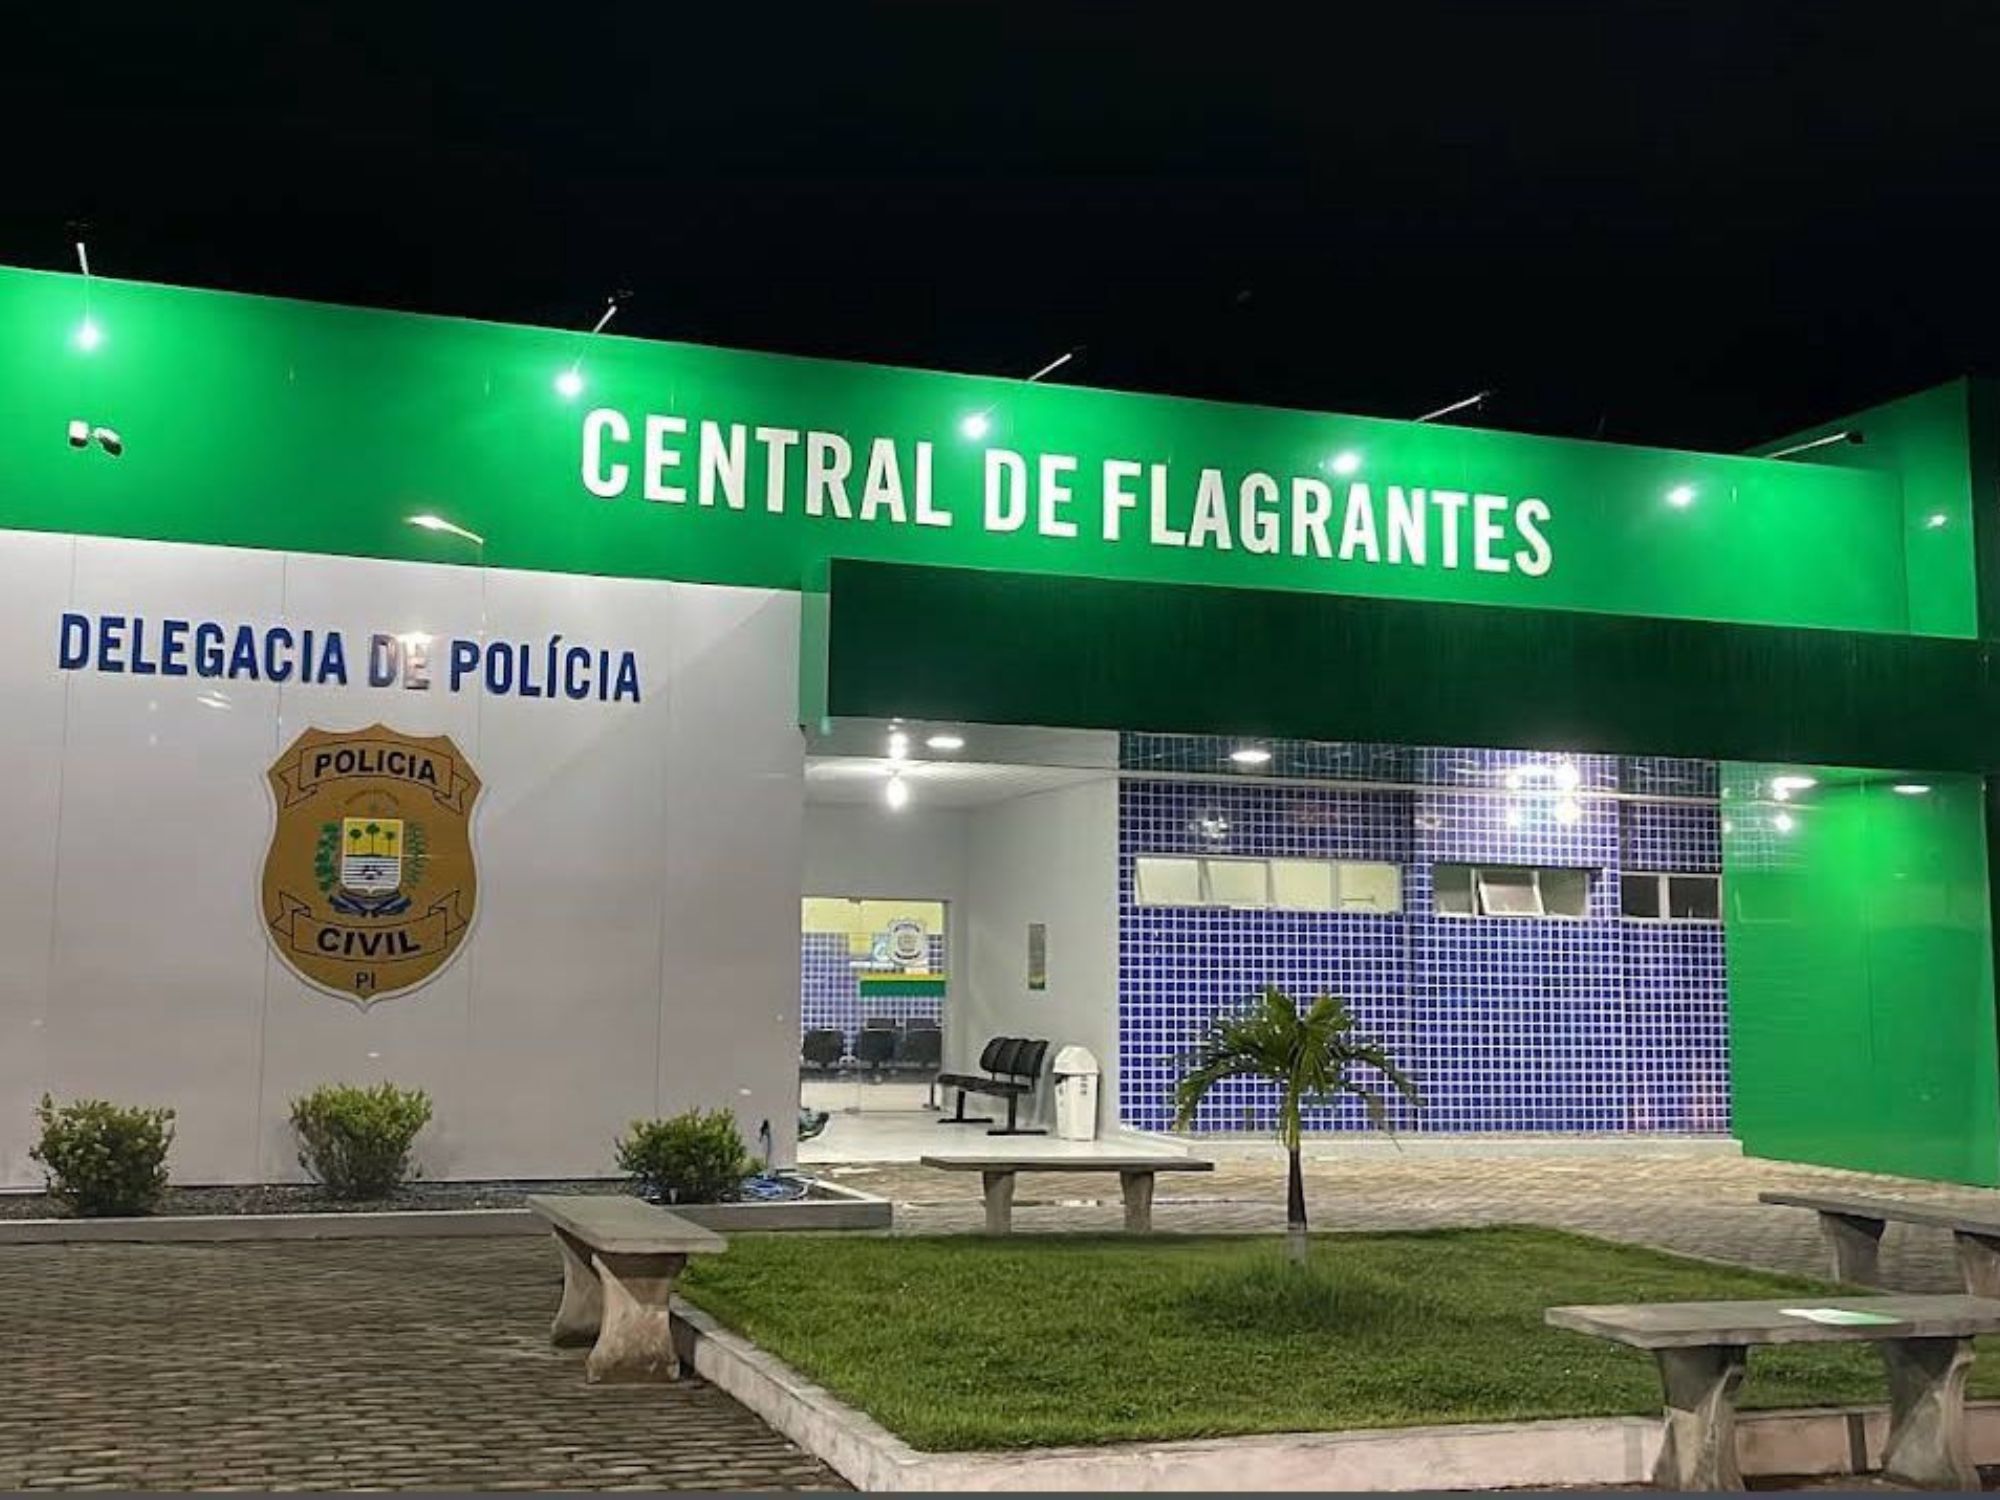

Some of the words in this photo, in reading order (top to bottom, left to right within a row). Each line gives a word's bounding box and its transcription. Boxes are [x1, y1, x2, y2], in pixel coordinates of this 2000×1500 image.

[581, 408, 953, 527] CENTRAL
[984, 448, 1078, 537] DE
[1103, 458, 1553, 577] FLAGRANTES
[59, 613, 347, 685] DELEGACIA
[368, 633, 432, 690] DE
[450, 634, 640, 703] POLÍCIA
[317, 927, 421, 956] CIVIL
[355, 972, 376, 989] PI
